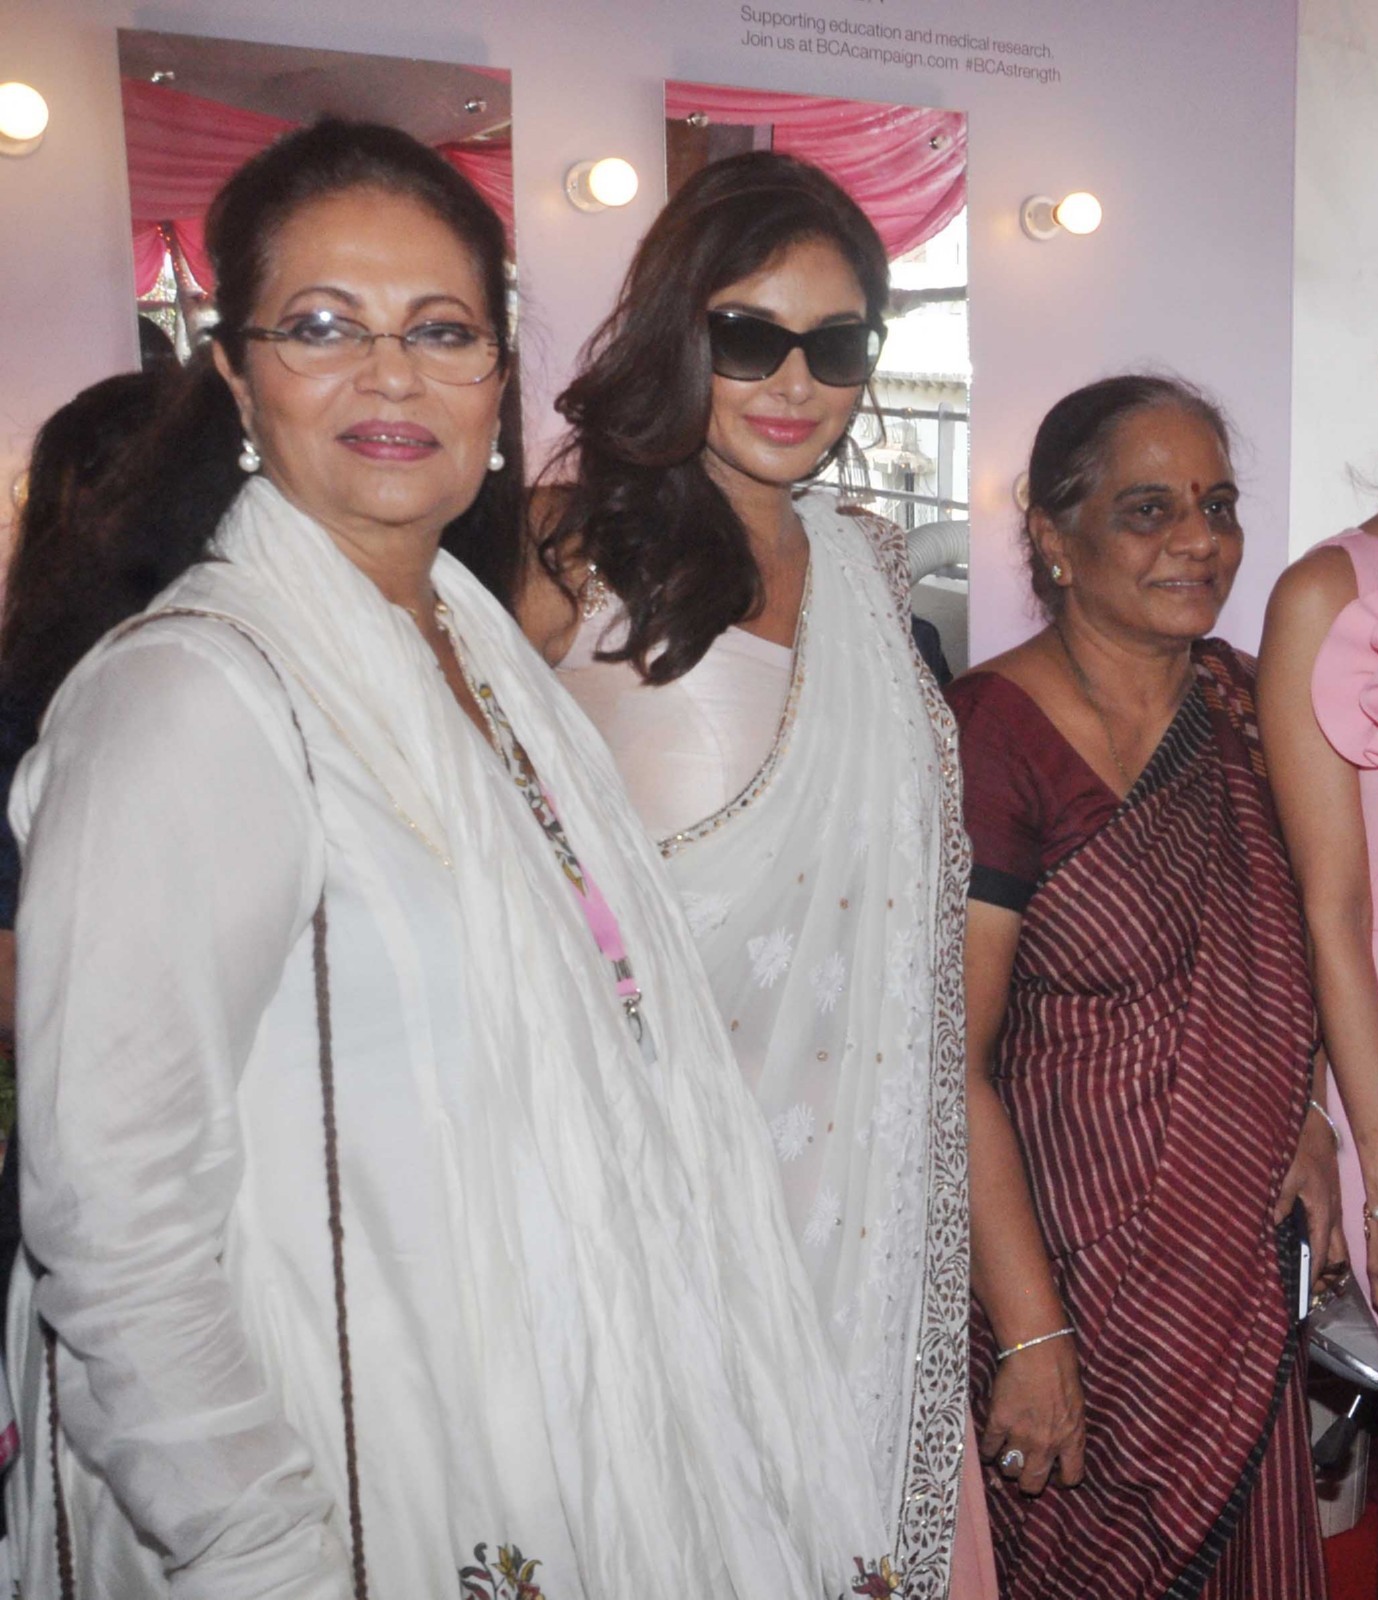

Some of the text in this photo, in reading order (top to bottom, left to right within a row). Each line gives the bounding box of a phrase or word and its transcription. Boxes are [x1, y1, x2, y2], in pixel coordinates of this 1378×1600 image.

[741, 5, 1055, 60] Supporting education and medical research.
[741, 30, 1061, 84] Join us at BCAcampaign.com #BCAstrength
